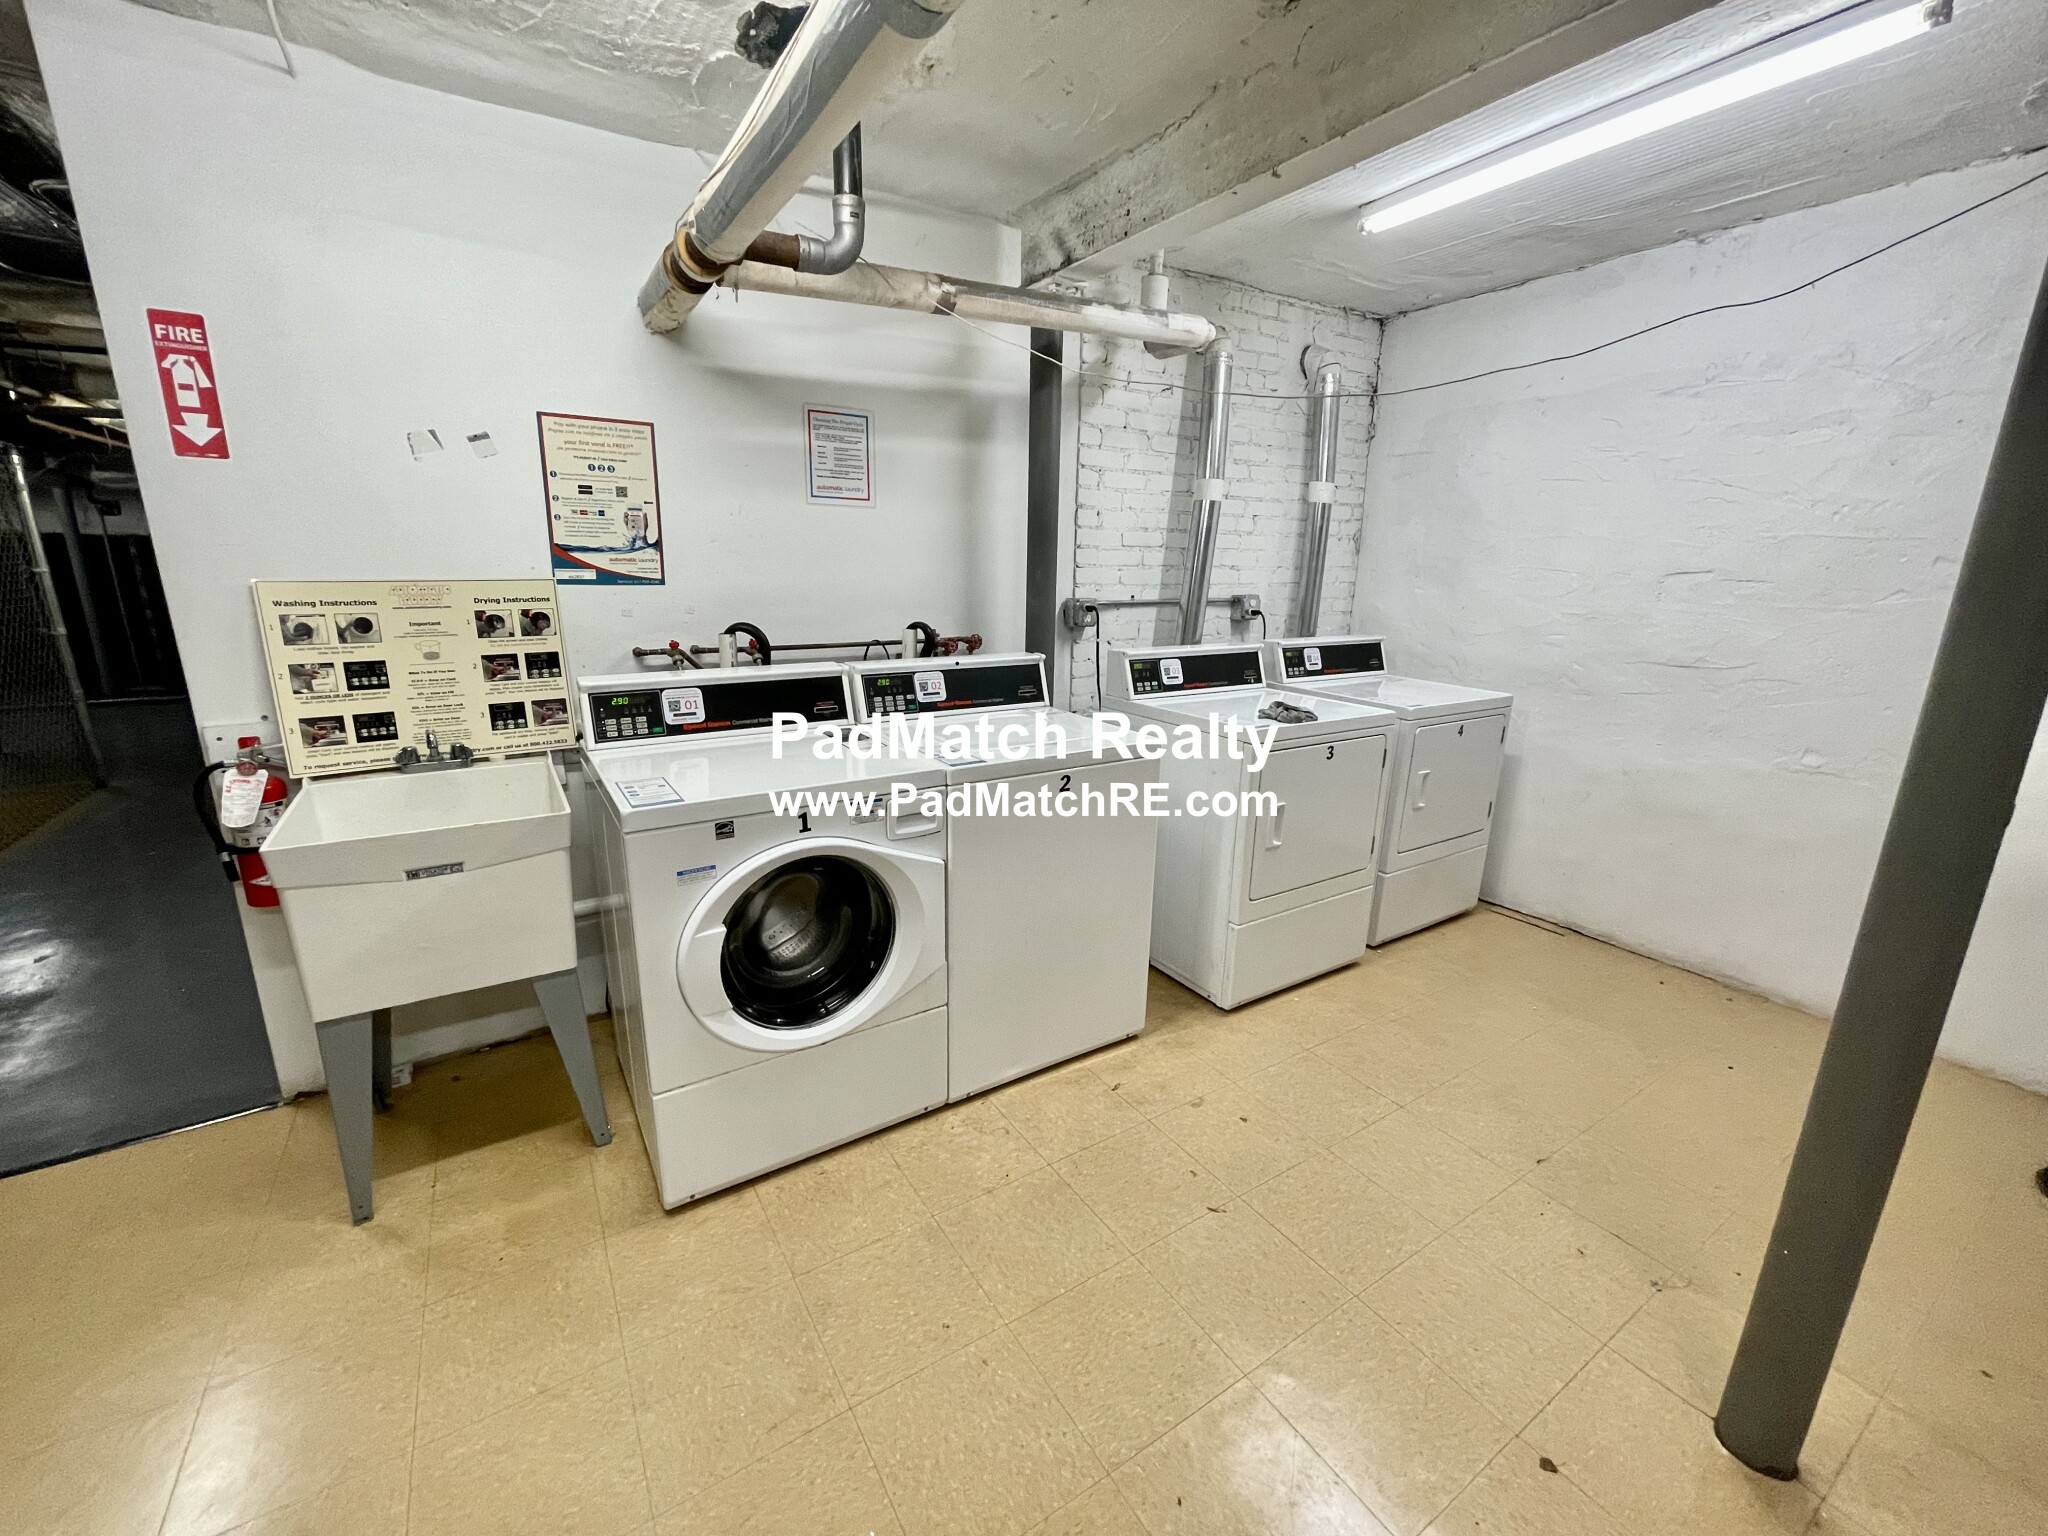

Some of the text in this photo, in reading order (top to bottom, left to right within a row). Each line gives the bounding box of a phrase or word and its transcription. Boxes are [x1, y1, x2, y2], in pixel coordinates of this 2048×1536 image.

[154, 323, 205, 344] FIRE
[816, 484, 844, 492] automatic
[272, 599, 377, 608] Washing Instructions
[474, 597, 500, 605] Drying
[1171, 667, 1180, 675] 03
[931, 681, 942, 690] 02
[684, 699, 699, 710] 01
[1457, 724, 1464, 737] 4
[1326, 745, 1335, 760] 3
[314, 762, 341, 770] request
[1059, 774, 1072, 793] 2
[797, 811, 812, 834] 1
